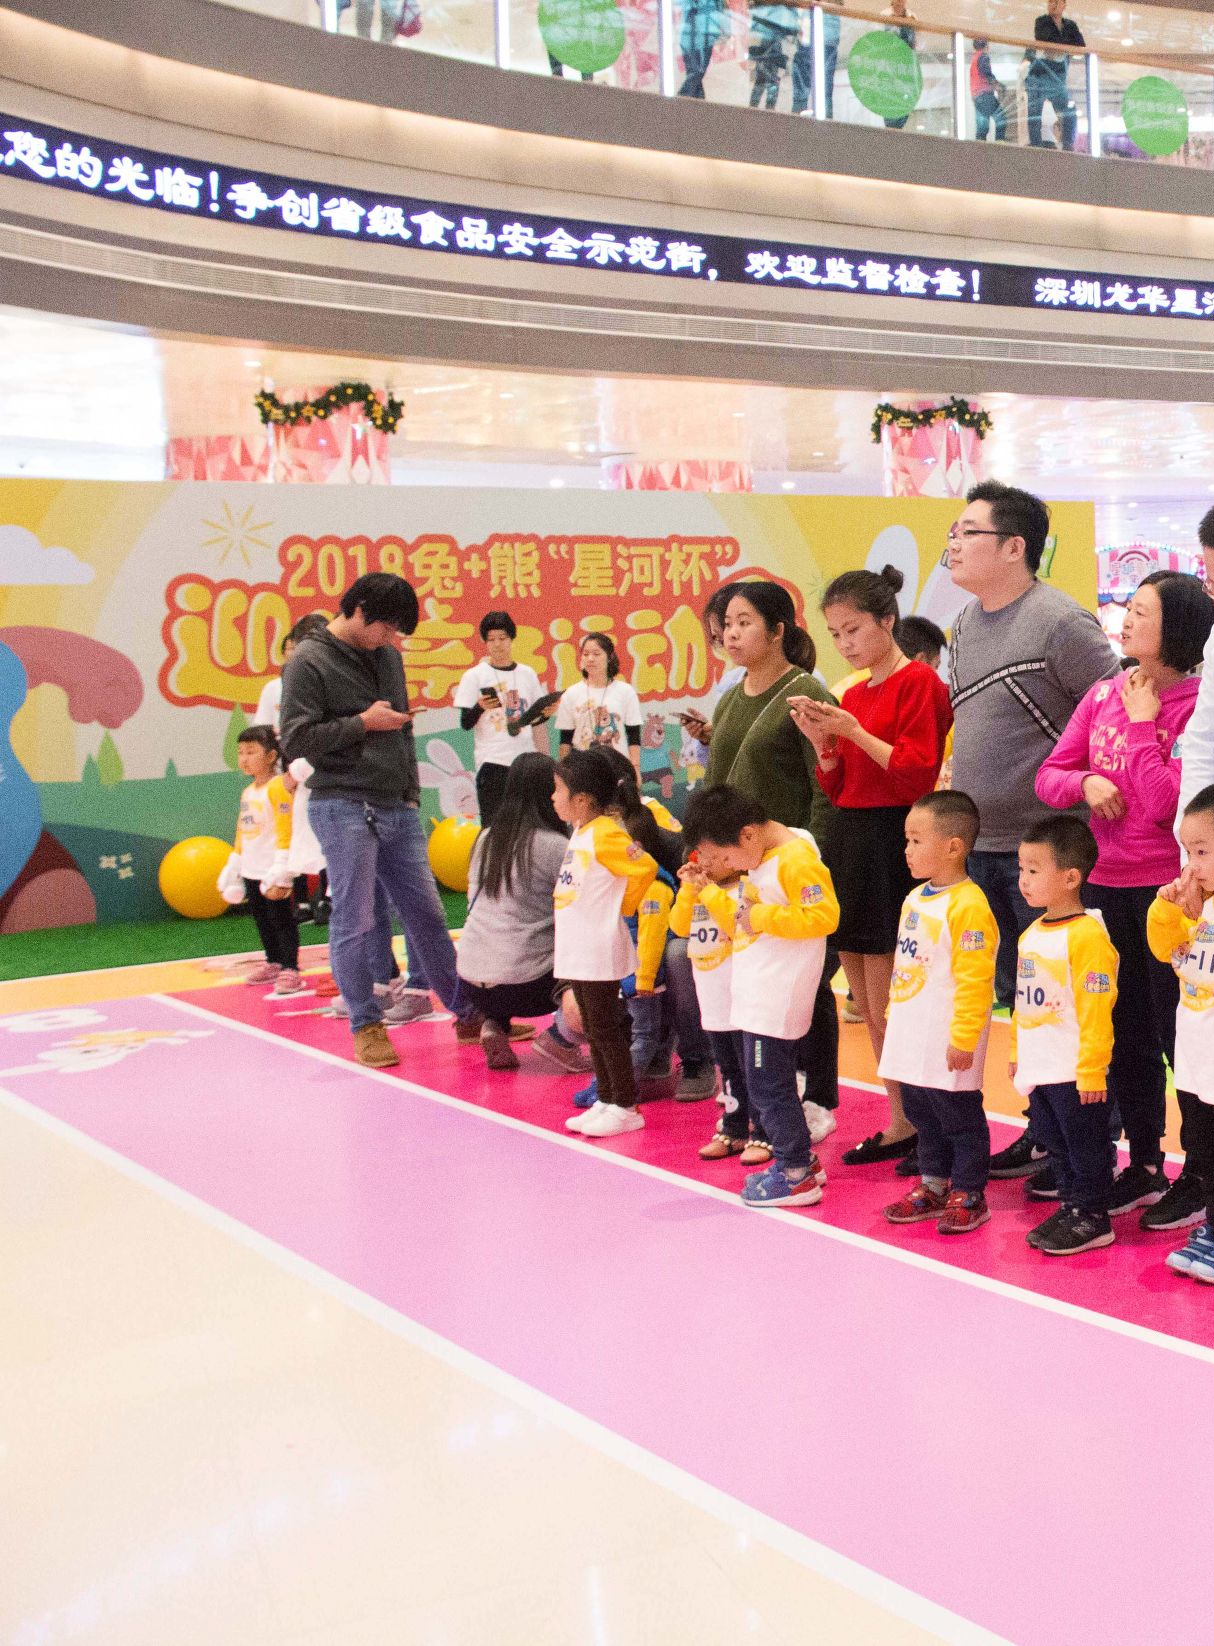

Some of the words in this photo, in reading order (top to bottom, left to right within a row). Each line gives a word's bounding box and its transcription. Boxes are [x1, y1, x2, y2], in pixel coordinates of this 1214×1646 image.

[745, 250, 982, 301] 欢迎监督检查!
